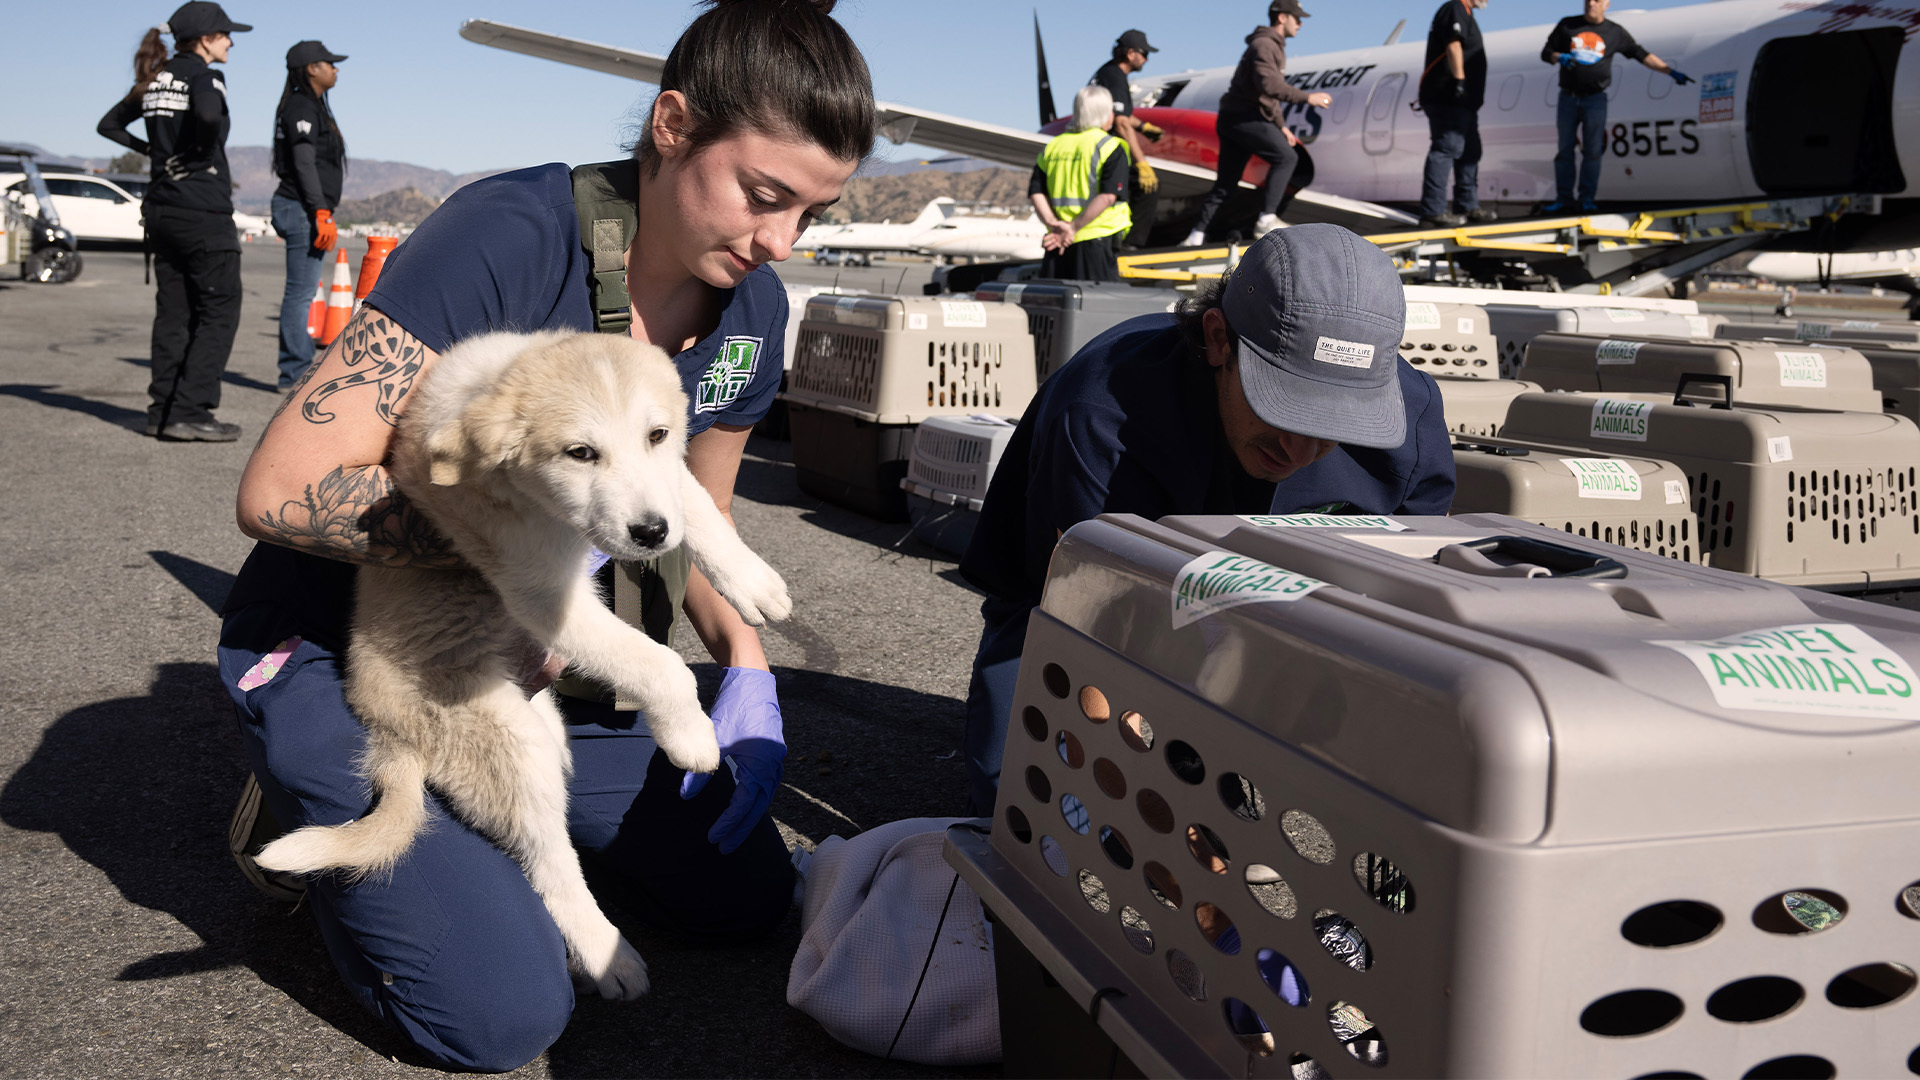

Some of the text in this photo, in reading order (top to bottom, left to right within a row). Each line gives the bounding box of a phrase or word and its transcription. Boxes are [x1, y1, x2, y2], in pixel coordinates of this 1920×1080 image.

[1603, 120, 1699, 157] 85ES
[1337, 345, 1355, 353] QUIET
[1784, 369, 1823, 382] ANIMALS
[1608, 402, 1637, 416] LIVE
[1594, 416, 1645, 435] ANIMALS
[1581, 462, 1618, 473] LIVE
[1582, 474, 1638, 492] ANIMALS
[1250, 516, 1389, 526] ANIMALS
[1176, 572, 1317, 609] ANIMALS
[1707, 653, 1912, 698] ANIMALS
